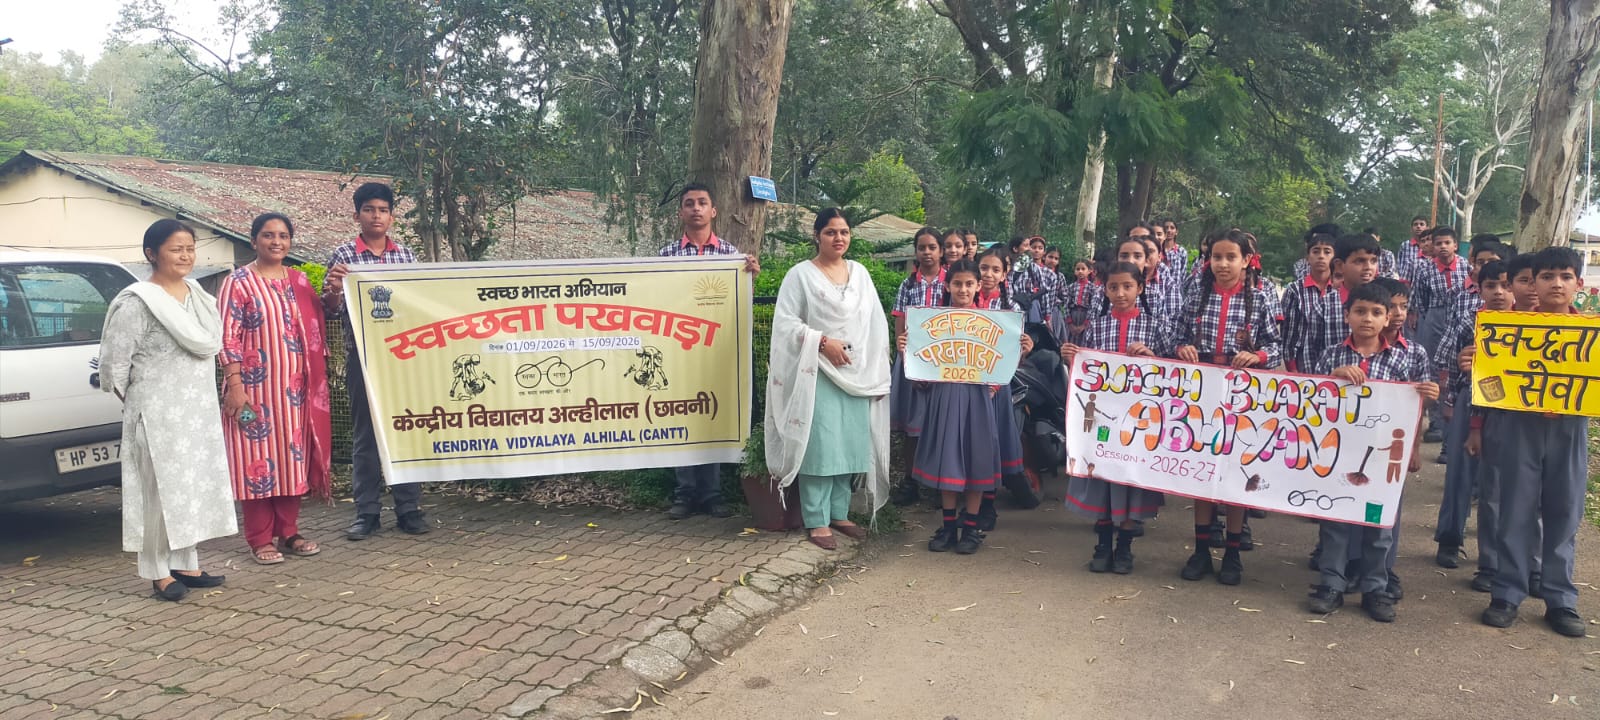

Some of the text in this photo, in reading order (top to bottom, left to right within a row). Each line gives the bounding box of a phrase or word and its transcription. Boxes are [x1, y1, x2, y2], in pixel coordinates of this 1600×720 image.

[477, 278, 627, 301] स्वच्छ भारत अभियान
[384, 303, 721, 360] स्वच्छता पखवाड़ा
[506, 339, 566, 352] 01/09/2026
[583, 336, 640, 347] 15/09/2026
[1480, 323, 1600, 363] स्वच्छता
[943, 367, 976, 380] 2026
[1504, 360, 1600, 412] सेवा
[1075, 359, 1373, 428] SWACHH BHARAT
[392, 391, 718, 434] केन्द्रीय विद्यालय अल्हीलाल (छावनी)
[432, 426, 689, 454] KENDRIYA VIDYALAYA ALHILAL (CANTT)
[1095, 443, 1138, 463] SESSION
[1119, 398, 1340, 478] ABHIYAN
[69, 449, 87, 467] HP
[92, 446, 110, 463] 53
